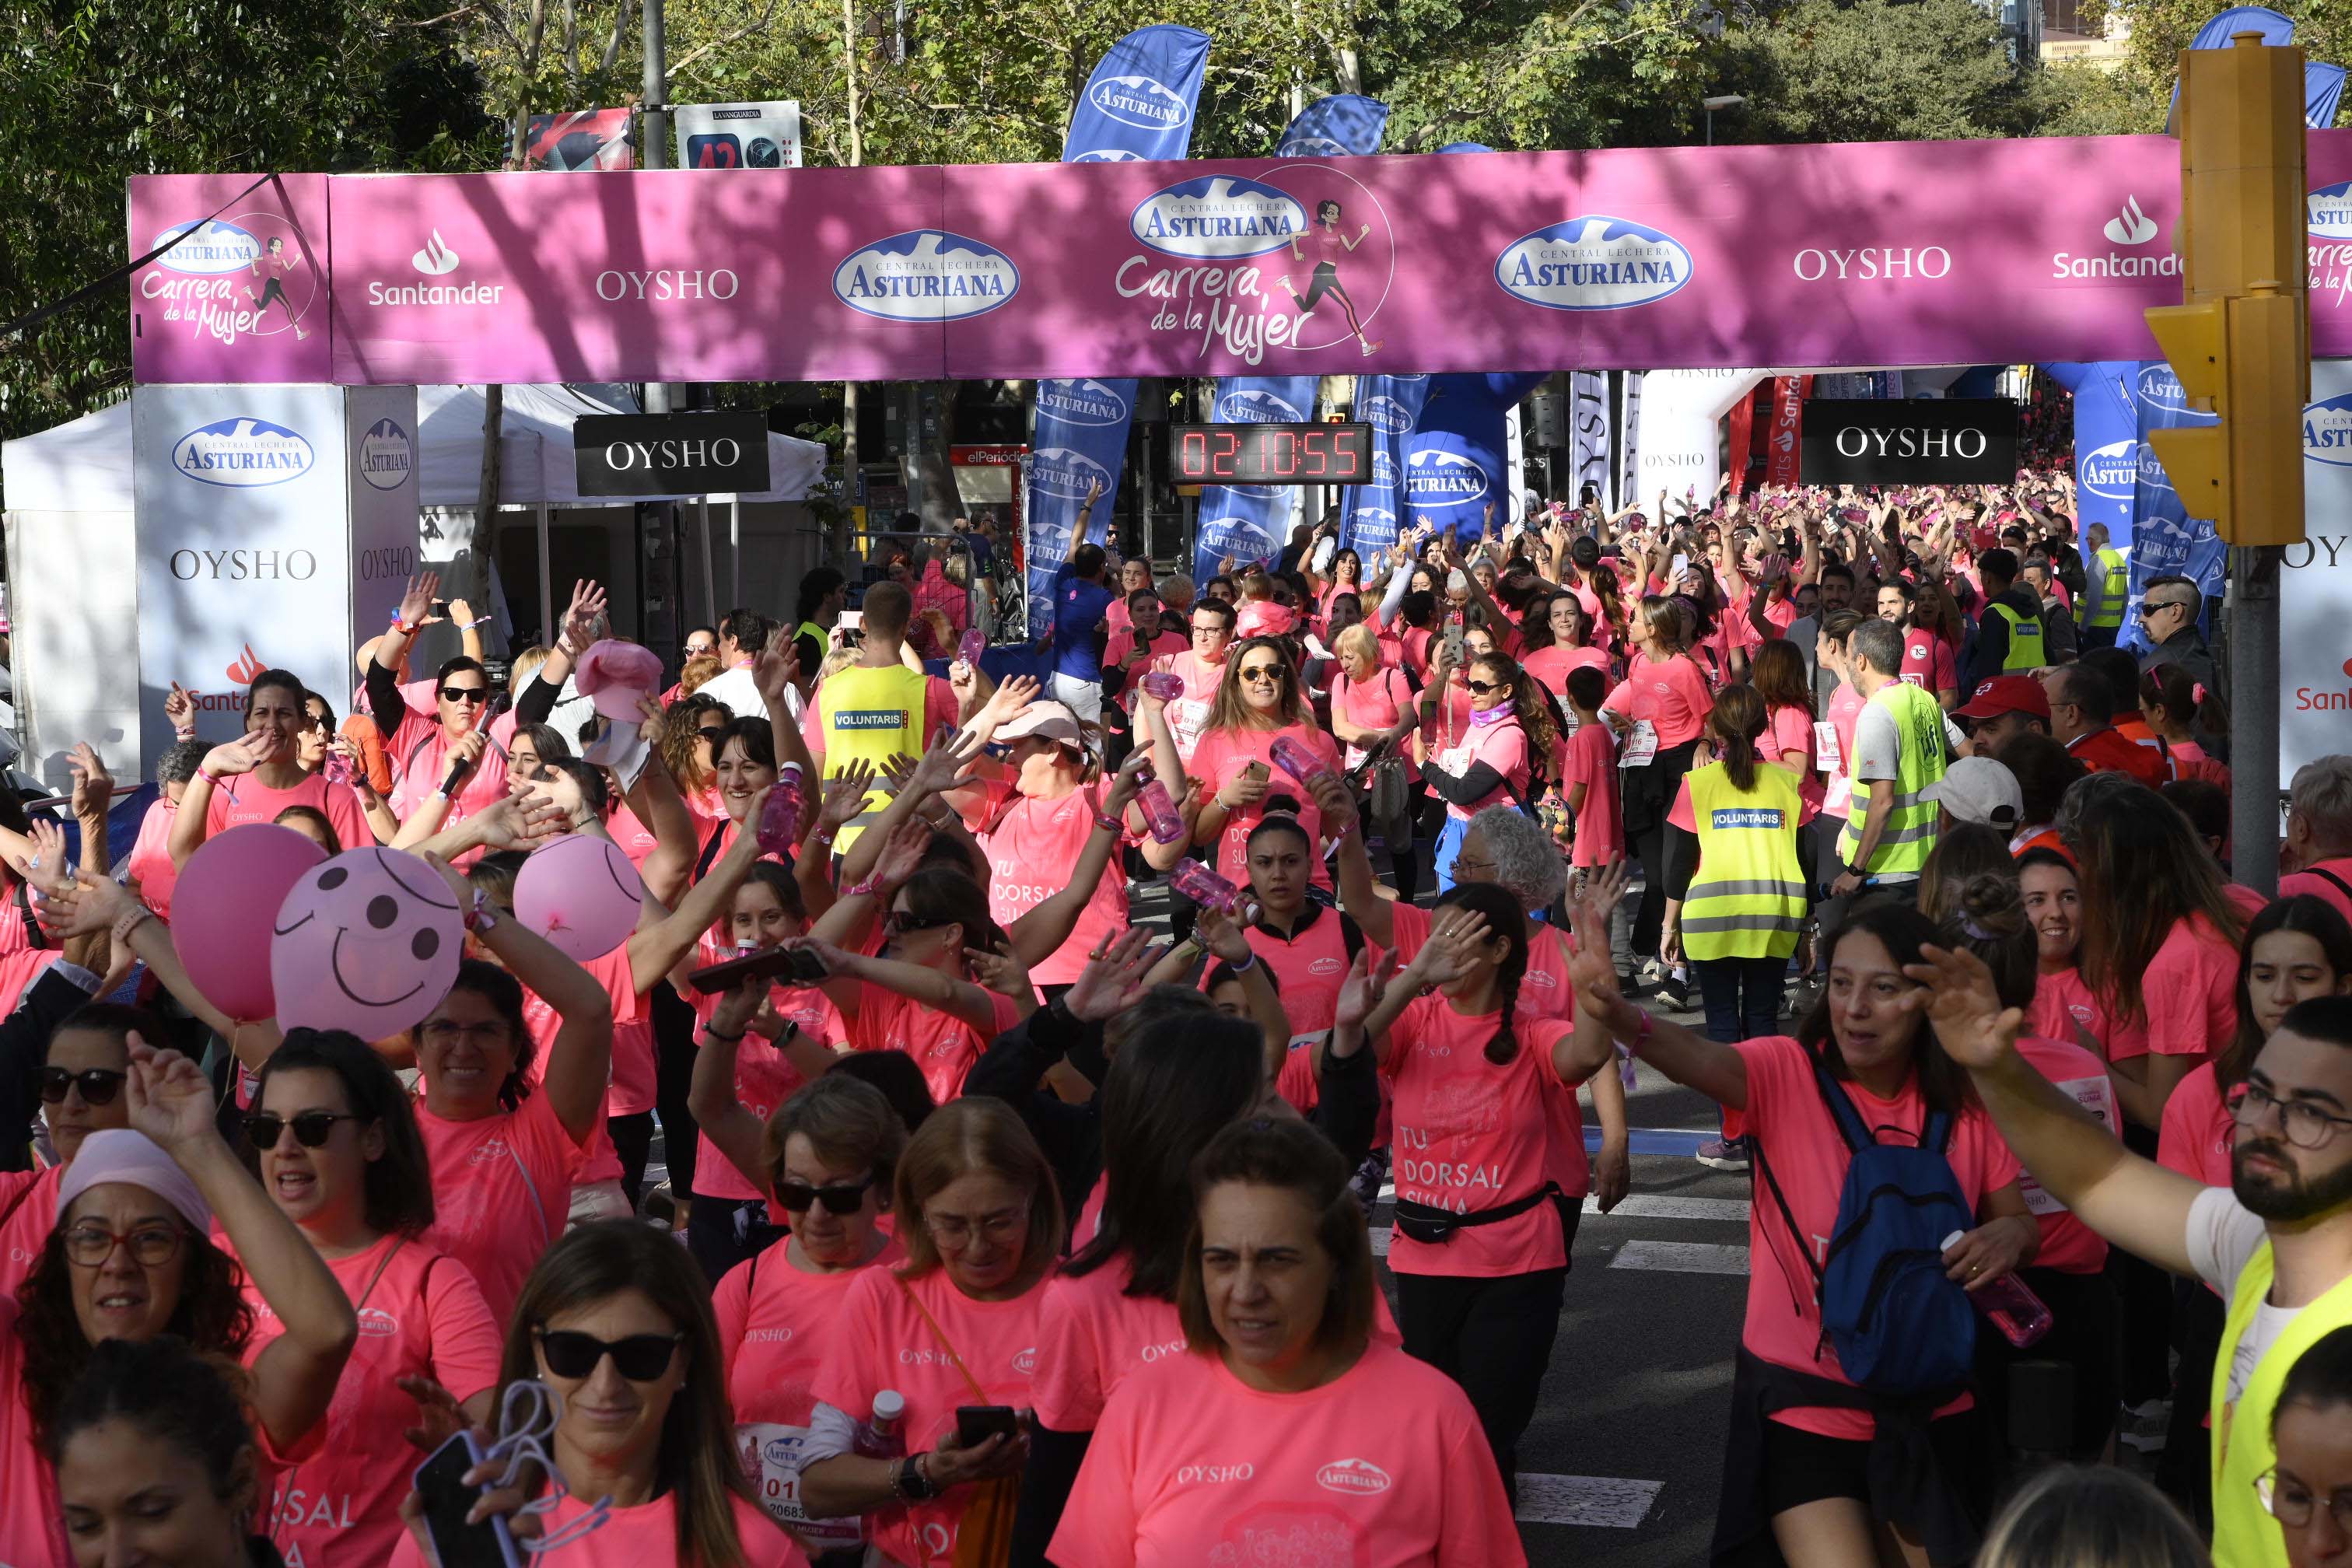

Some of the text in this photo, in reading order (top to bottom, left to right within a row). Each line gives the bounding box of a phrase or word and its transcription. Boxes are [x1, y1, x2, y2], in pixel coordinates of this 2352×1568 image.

[1096, 85, 1181, 124] ASTURIANA
[1231, 203, 1288, 212] LECHERA
[1143, 207, 1296, 238] ASTURIANA
[876, 261, 999, 271] CENTRAL LECHERA
[1541, 247, 1671, 259] CENTRAL LECHERA
[1794, 247, 1951, 281] OYSHO
[847, 264, 1006, 298] ASTURIANA
[1115, 255, 1261, 298] Carrera
[1510, 252, 1678, 287] ASTURIANA
[2325, 268, 2340, 289] la
[142, 271, 233, 299] Carrera
[369, 281, 504, 306] Santander
[596, 270, 739, 301] OYSHO
[164, 297, 268, 345] de la Mujer
[1151, 293, 1314, 366] de la Mujer
[2141, 375, 2186, 398] ASTU
[1036, 385, 1118, 420] ASTURIANA
[606, 437, 740, 470] OYSHO
[1183, 432, 1356, 475] 02:10:55
[1836, 426, 1986, 457] OYSHO
[184, 443, 304, 469] ASTURIANA
[363, 445, 409, 473] ASTURIANA
[1646, 453, 1703, 467] OYSHO
[1202, 530, 1272, 558] ASTURIANA
[170, 549, 317, 581] OYSHO
[362, 546, 413, 581] OYSHO
[835, 715, 900, 725] VOLUNTARIS
[232, 812, 263, 821] OYSHO
[1713, 813, 1779, 824] VOLUNTARIS
[996, 859, 1014, 877] TU
[996, 884, 1064, 902] DORSA
[1400, 1125, 1427, 1150] TU
[1404, 1159, 1503, 1188] DORSAL
[1178, 1462, 1255, 1484] OYSHO
[1325, 1468, 1384, 1489] ASTURIANA
[769, 1503, 807, 1519] 20683
